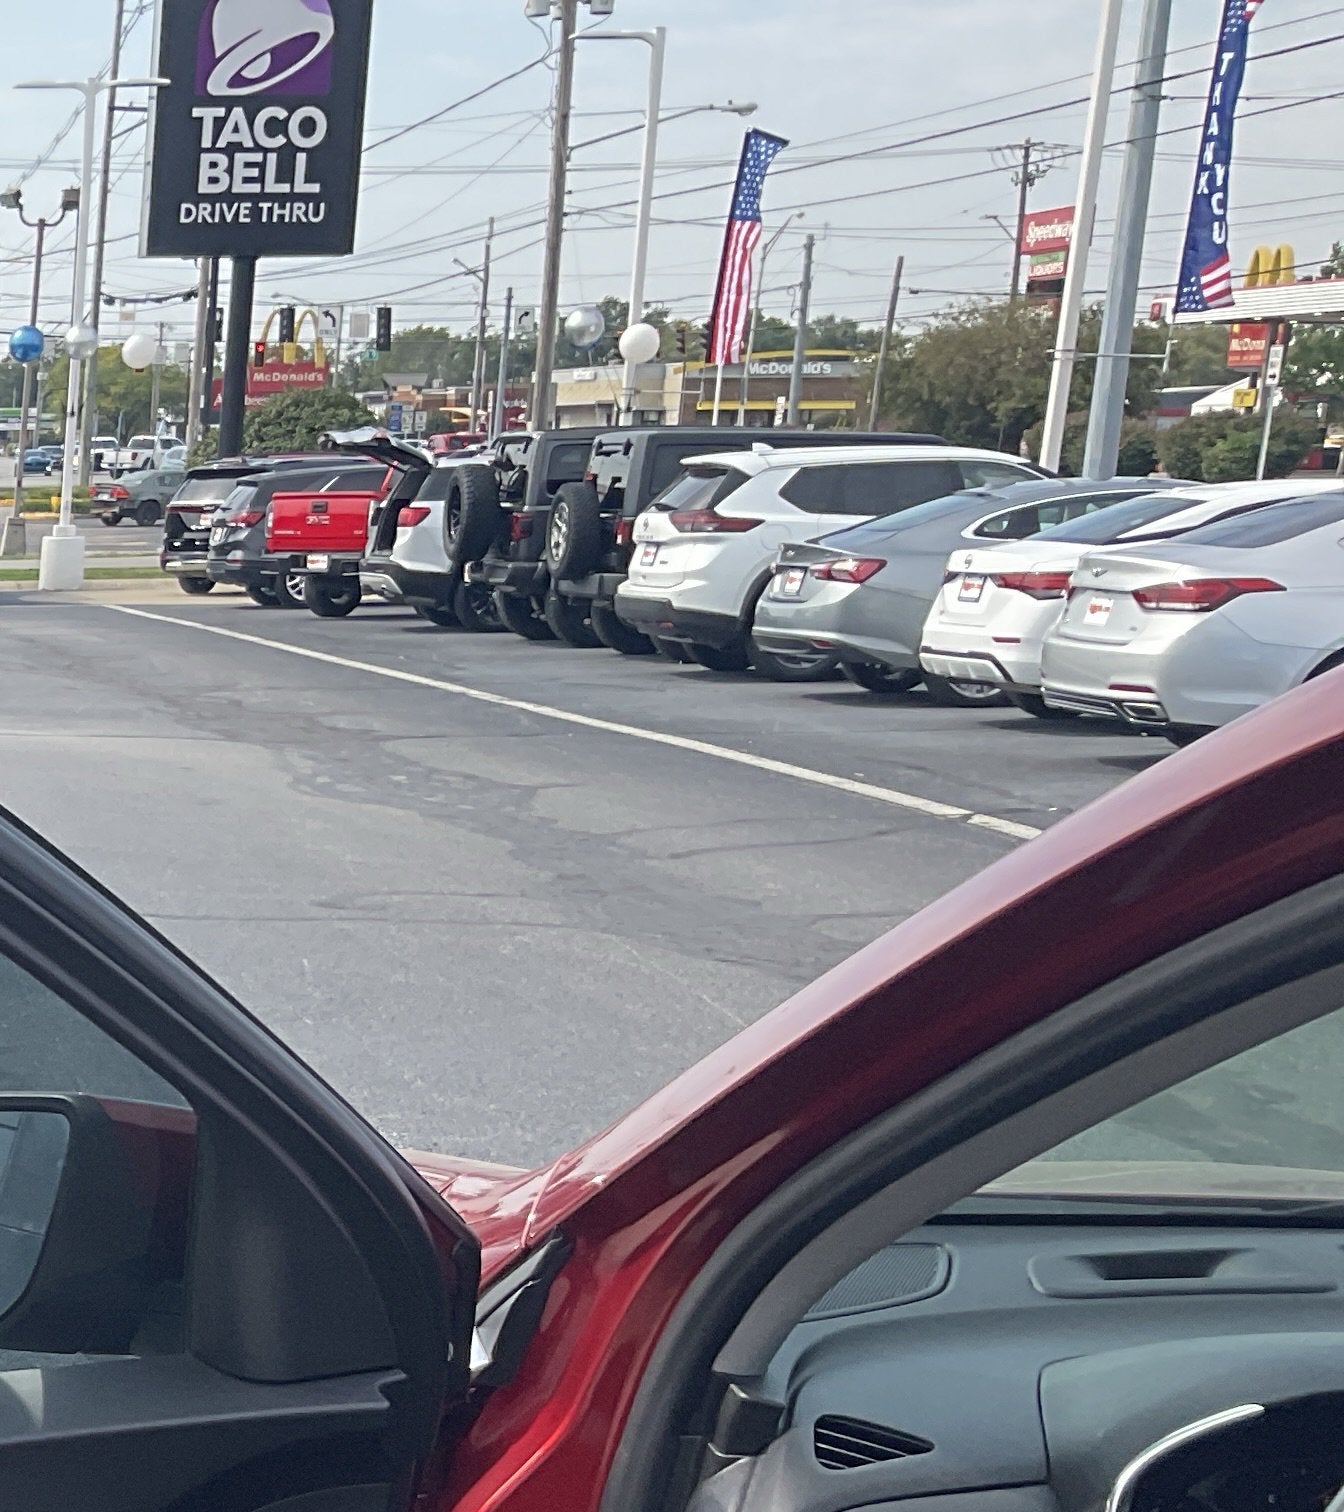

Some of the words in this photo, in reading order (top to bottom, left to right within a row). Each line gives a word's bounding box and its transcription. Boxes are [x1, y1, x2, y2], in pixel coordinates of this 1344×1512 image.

[191, 105, 328, 149] TACO
[1196, 52, 1235, 195] THANK
[197, 152, 321, 194] BELL
[179, 202, 251, 223] DRIVE
[258, 202, 325, 223] THRU
[253, 371, 324, 382] McDonald's
